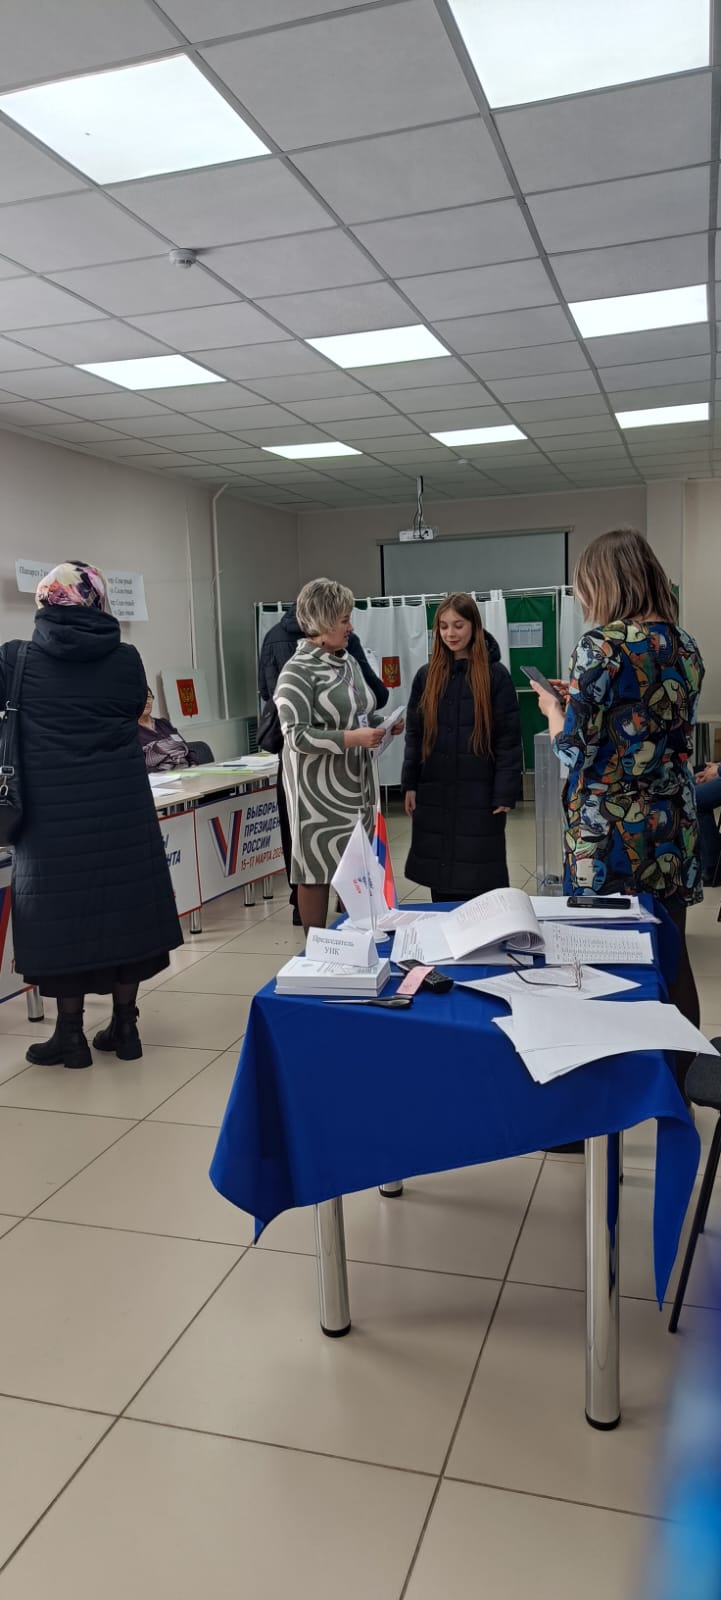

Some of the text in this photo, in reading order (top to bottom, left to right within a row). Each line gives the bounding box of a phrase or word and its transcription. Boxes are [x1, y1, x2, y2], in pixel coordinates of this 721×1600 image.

[244, 816, 281, 838] ПРЕЗИДЕН
[242, 835, 271, 856] РОССИИ
[255, 850, 272, 865] МАРТА
